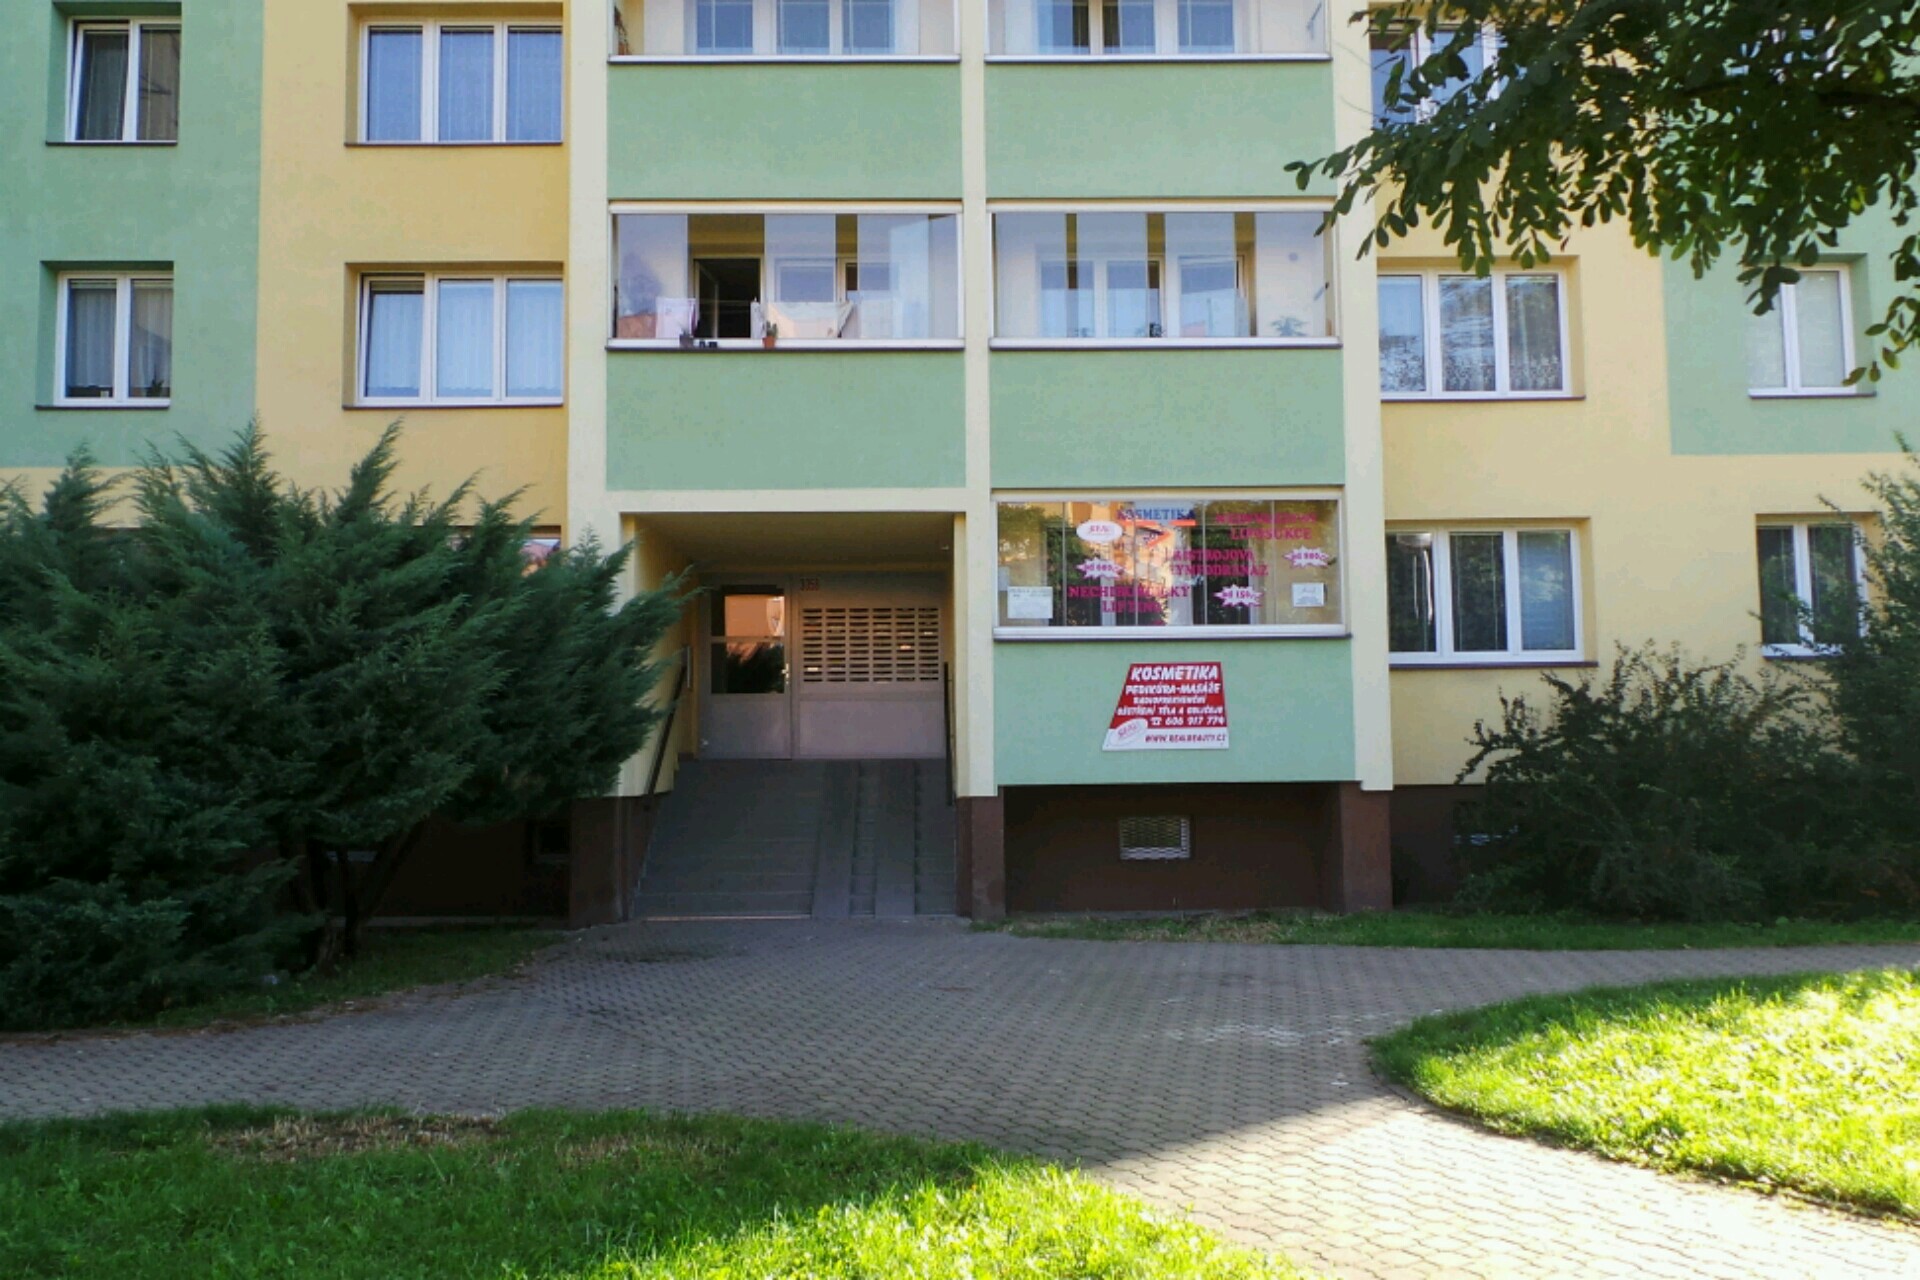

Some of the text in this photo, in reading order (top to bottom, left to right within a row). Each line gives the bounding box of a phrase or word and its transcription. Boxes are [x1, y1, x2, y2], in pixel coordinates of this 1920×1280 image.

[1117, 509, 1196, 520] KOSMETIKA
[1230, 528, 1312, 540] LIPOSUKCE
[1067, 583, 1190, 598] NECHIRURGCKÝ
[1103, 601, 1161, 613] LIFTING
[1131, 666, 1218, 681] KOSMETIKA
